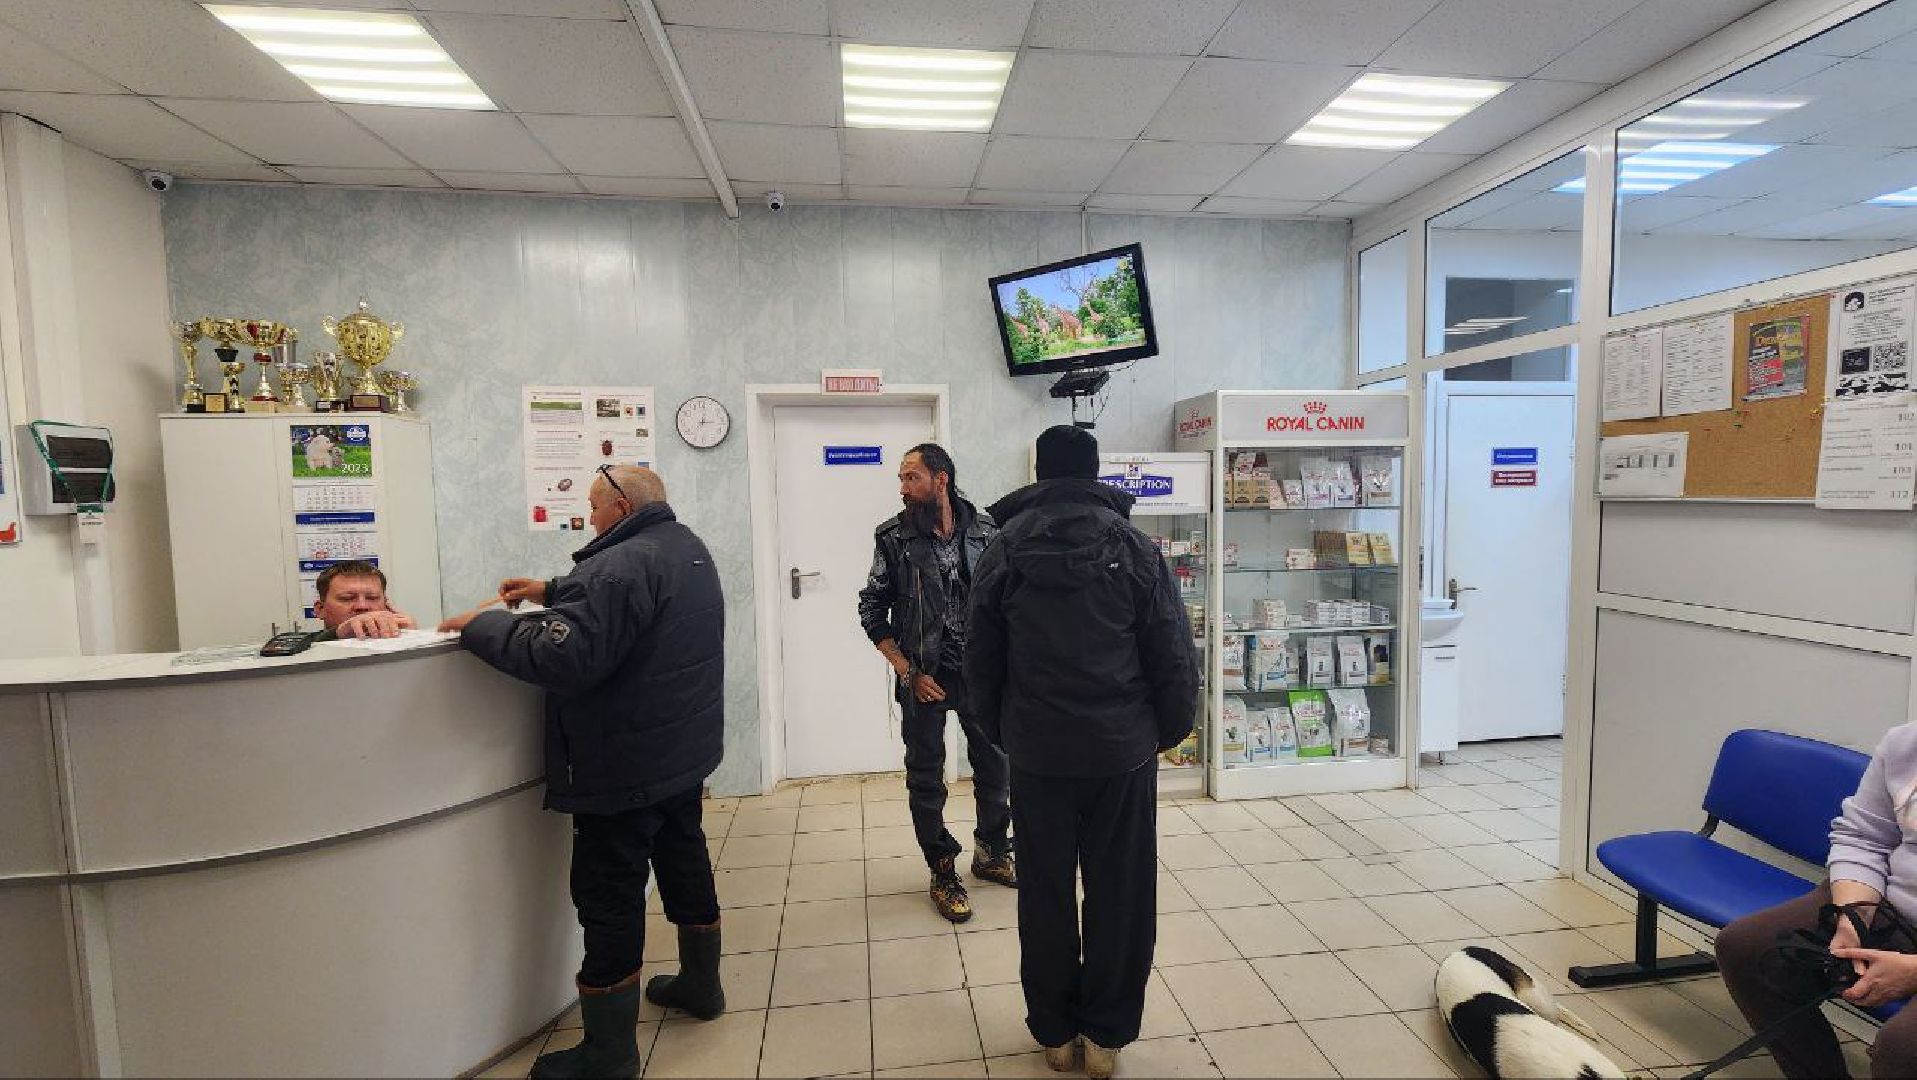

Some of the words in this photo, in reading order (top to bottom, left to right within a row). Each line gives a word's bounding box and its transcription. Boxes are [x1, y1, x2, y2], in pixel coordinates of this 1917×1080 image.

[1267, 416, 1314, 431] ROYAL
[1316, 416, 1365, 431] CANIN
[341, 463, 369, 474] 2023
